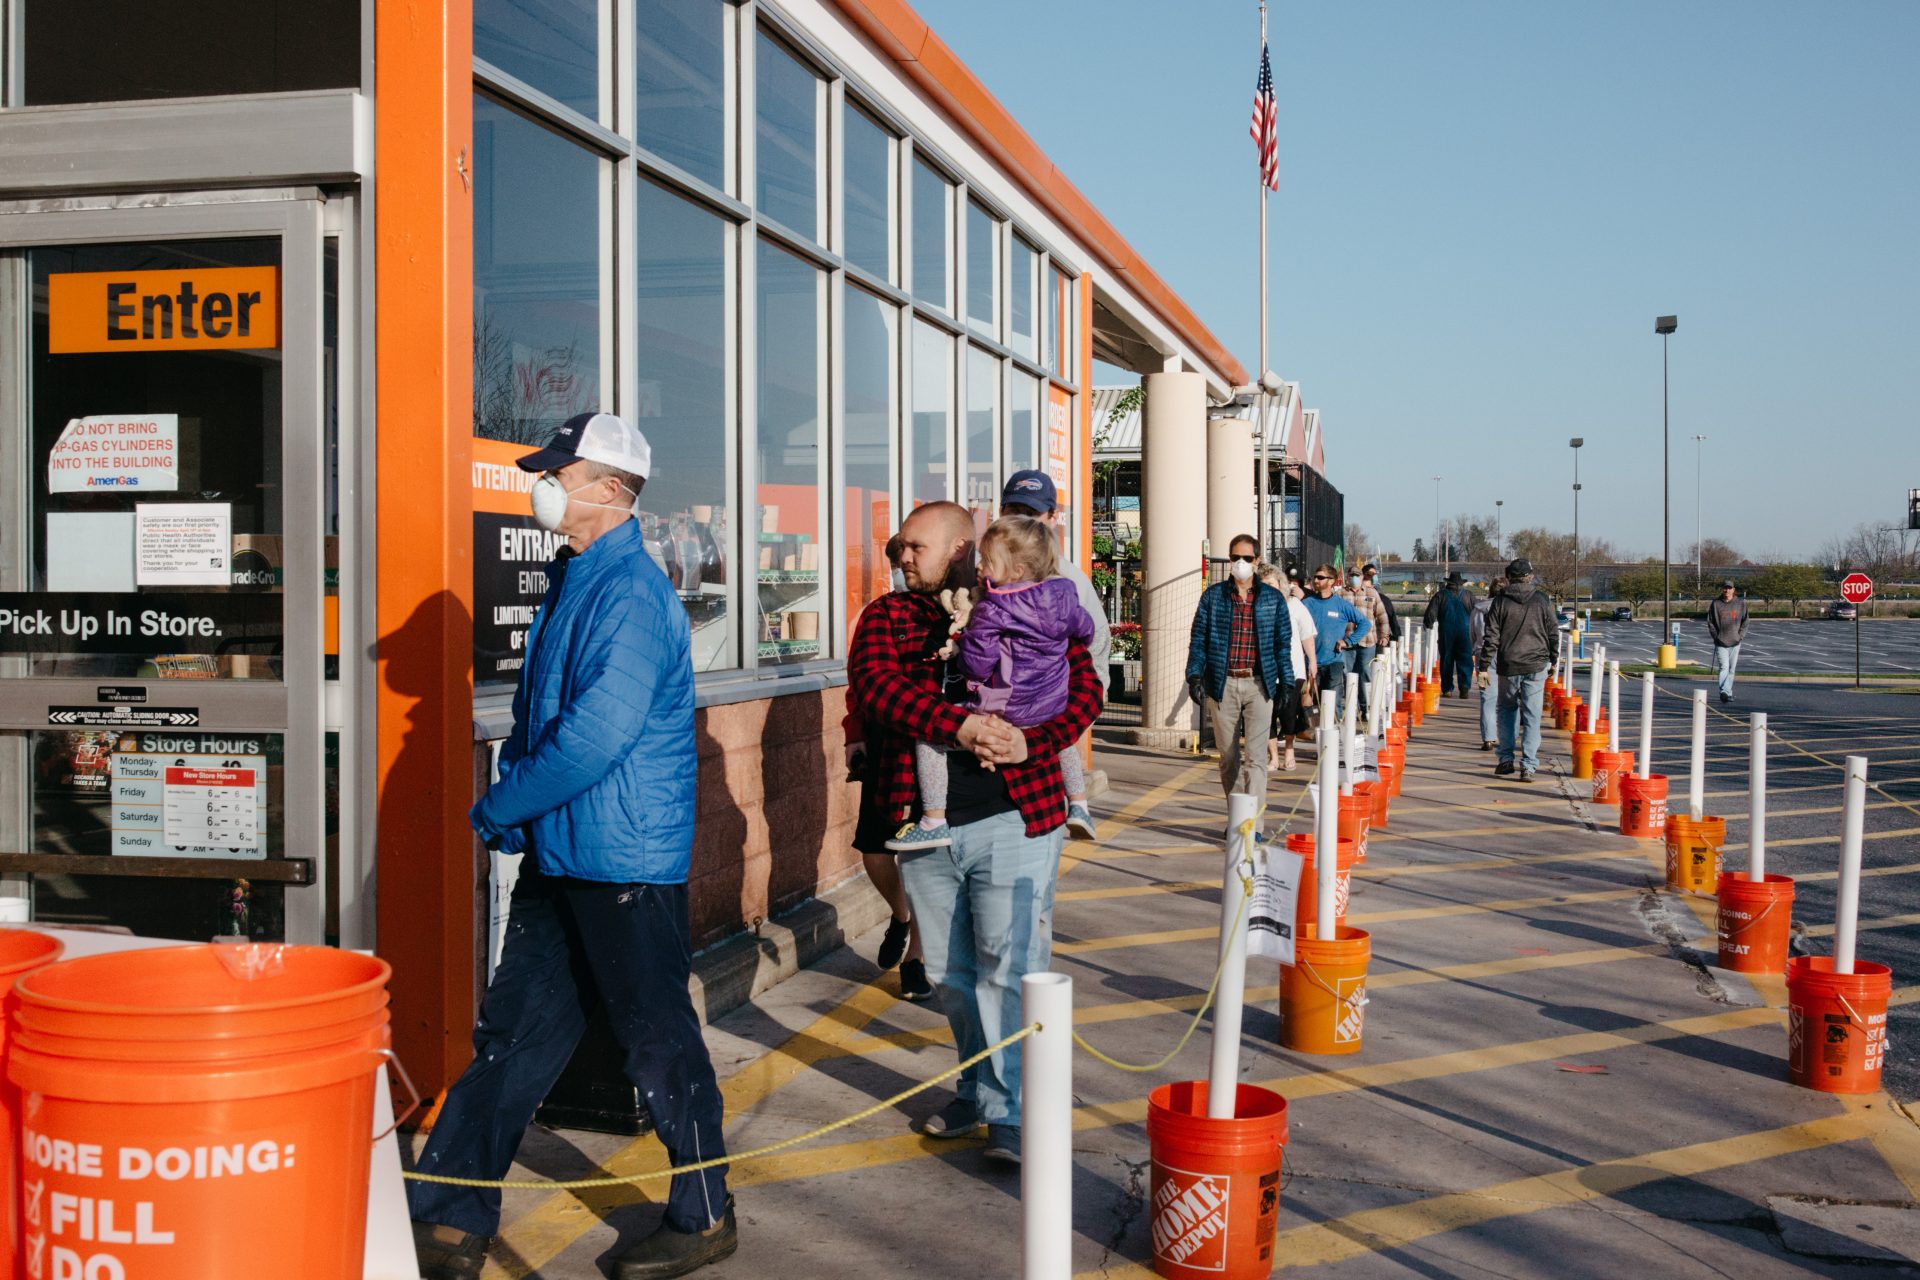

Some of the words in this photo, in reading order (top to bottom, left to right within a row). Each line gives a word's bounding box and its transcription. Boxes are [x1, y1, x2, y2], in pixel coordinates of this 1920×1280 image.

[107, 281, 261, 340] Enter
[88, 423, 114, 435] NOT
[118, 422, 158, 434] BRING
[102, 439, 173, 451] CYLINDERS
[53, 457, 81, 469] INTO
[85, 457, 109, 468] THE
[113, 456, 173, 467] BUILDING
[87, 476, 138, 486] AmeriGas
[1843, 583, 1870, 595] STOP
[493, 605, 534, 625] LIMITING
[0, 609, 52, 635] Pick
[60, 610, 99, 641] Up
[107, 610, 132, 636] In
[140, 610, 223, 637] Store.
[511, 630, 524, 650] OF
[142, 735, 196, 753] Store
[200, 736, 259, 755] Hours
[120, 757, 157, 766] Monday-
[120, 767, 159, 778] Thursday
[216, 772, 237, 780] Hours
[120, 788, 146, 798] Friday
[207, 802, 213, 812] 6
[120, 812, 159, 823] Saturday
[207, 816, 213, 827] 6
[120, 837, 153, 848] Sunday
[208, 831, 213, 840] 8
[239, 832, 244, 841] 6
[118, 1139, 296, 1181] DOING:
[1154, 1178, 1181, 1210] THE
[51, 1190, 175, 1245] FILL
[1152, 1176, 1227, 1254] HOME
[1169, 1211, 1226, 1264] DEPOT
[52, 1245, 125, 1280] DO
